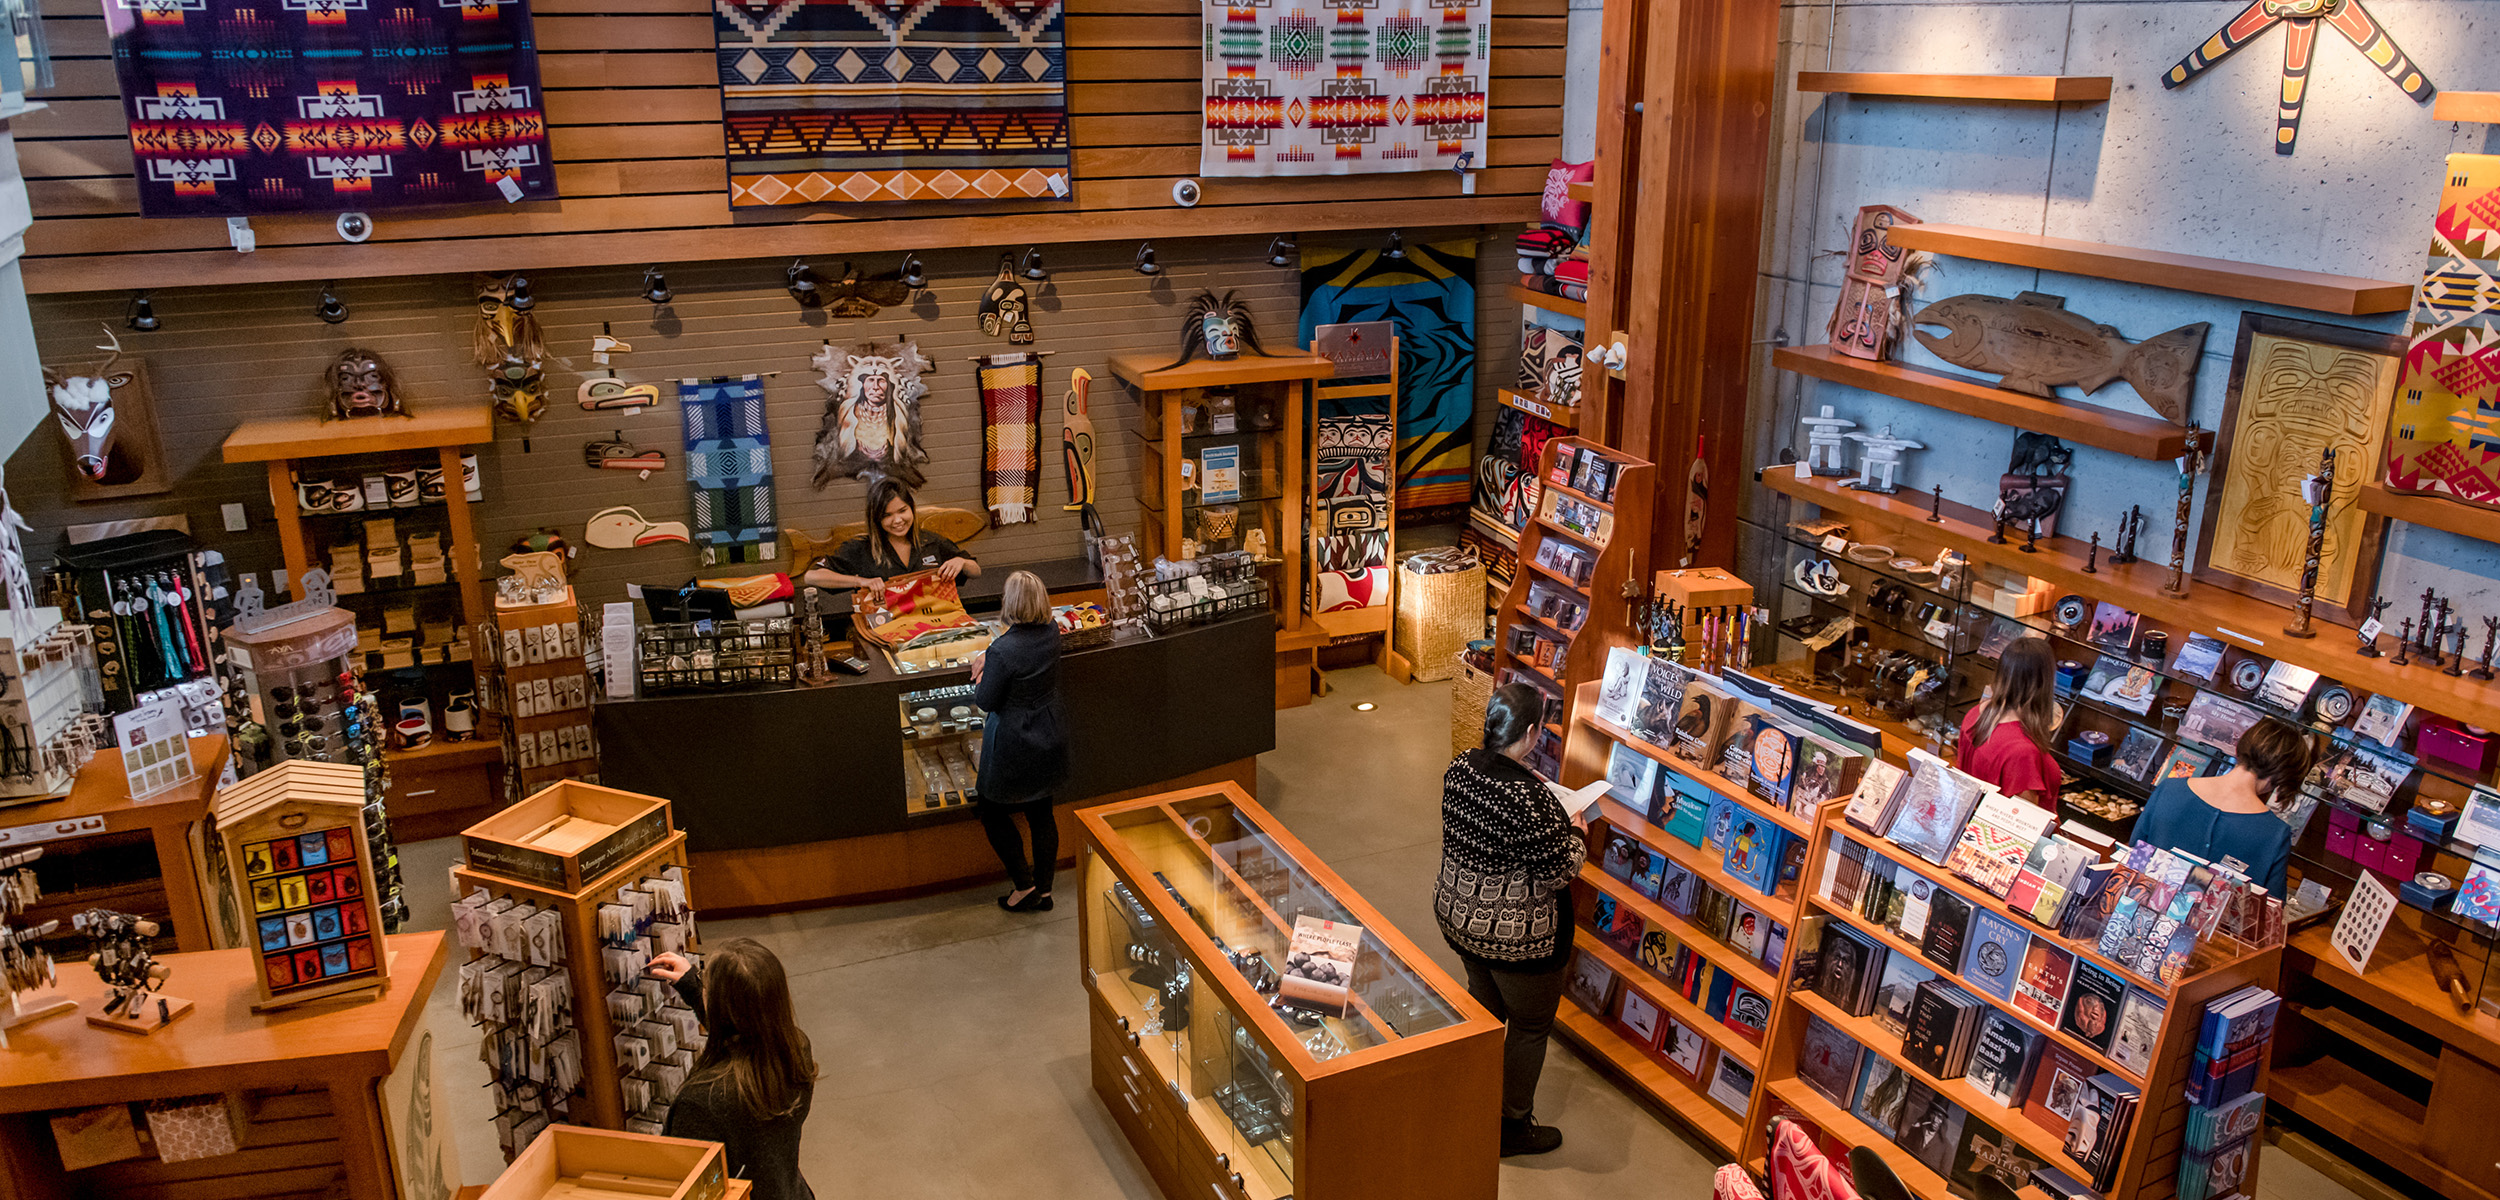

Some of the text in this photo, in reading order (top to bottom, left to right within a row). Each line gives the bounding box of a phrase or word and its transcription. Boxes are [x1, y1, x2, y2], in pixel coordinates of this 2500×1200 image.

[2100, 655, 2132, 669] MOSQUITO
[1652, 665, 1680, 683] VOICES
[1660, 684, 1683, 701] WILD
[2221, 712, 2237, 724] Heart
[1675, 727, 1695, 741] Rainbow
[1694, 738, 1707, 748] Crow
[2017, 877, 2036, 888] INDIAN
[1981, 916, 2021, 941] RAVEN'S
[1298, 932, 1316, 940] WHERE
[1317, 936, 1335, 944] PEOPLE
[1988, 931, 2008, 946] CRY
[2027, 962, 2063, 985] EARTH'S
[2081, 963, 2097, 977] Being
[2104, 975, 2121, 992] Being
[1989, 977, 2005, 989] Harris
[1919, 1010, 1933, 1021] THAT
[1921, 1003, 1931, 1013] ALL
[1989, 1016, 2005, 1031] The
[1914, 1030, 1929, 1043] OURS
[1985, 1027, 2021, 1054] Amazing
[1982, 1035, 2006, 1055] Mazie
[1979, 1045, 2004, 1064] Baker
[1970, 1144, 2030, 1178] TRADITION
